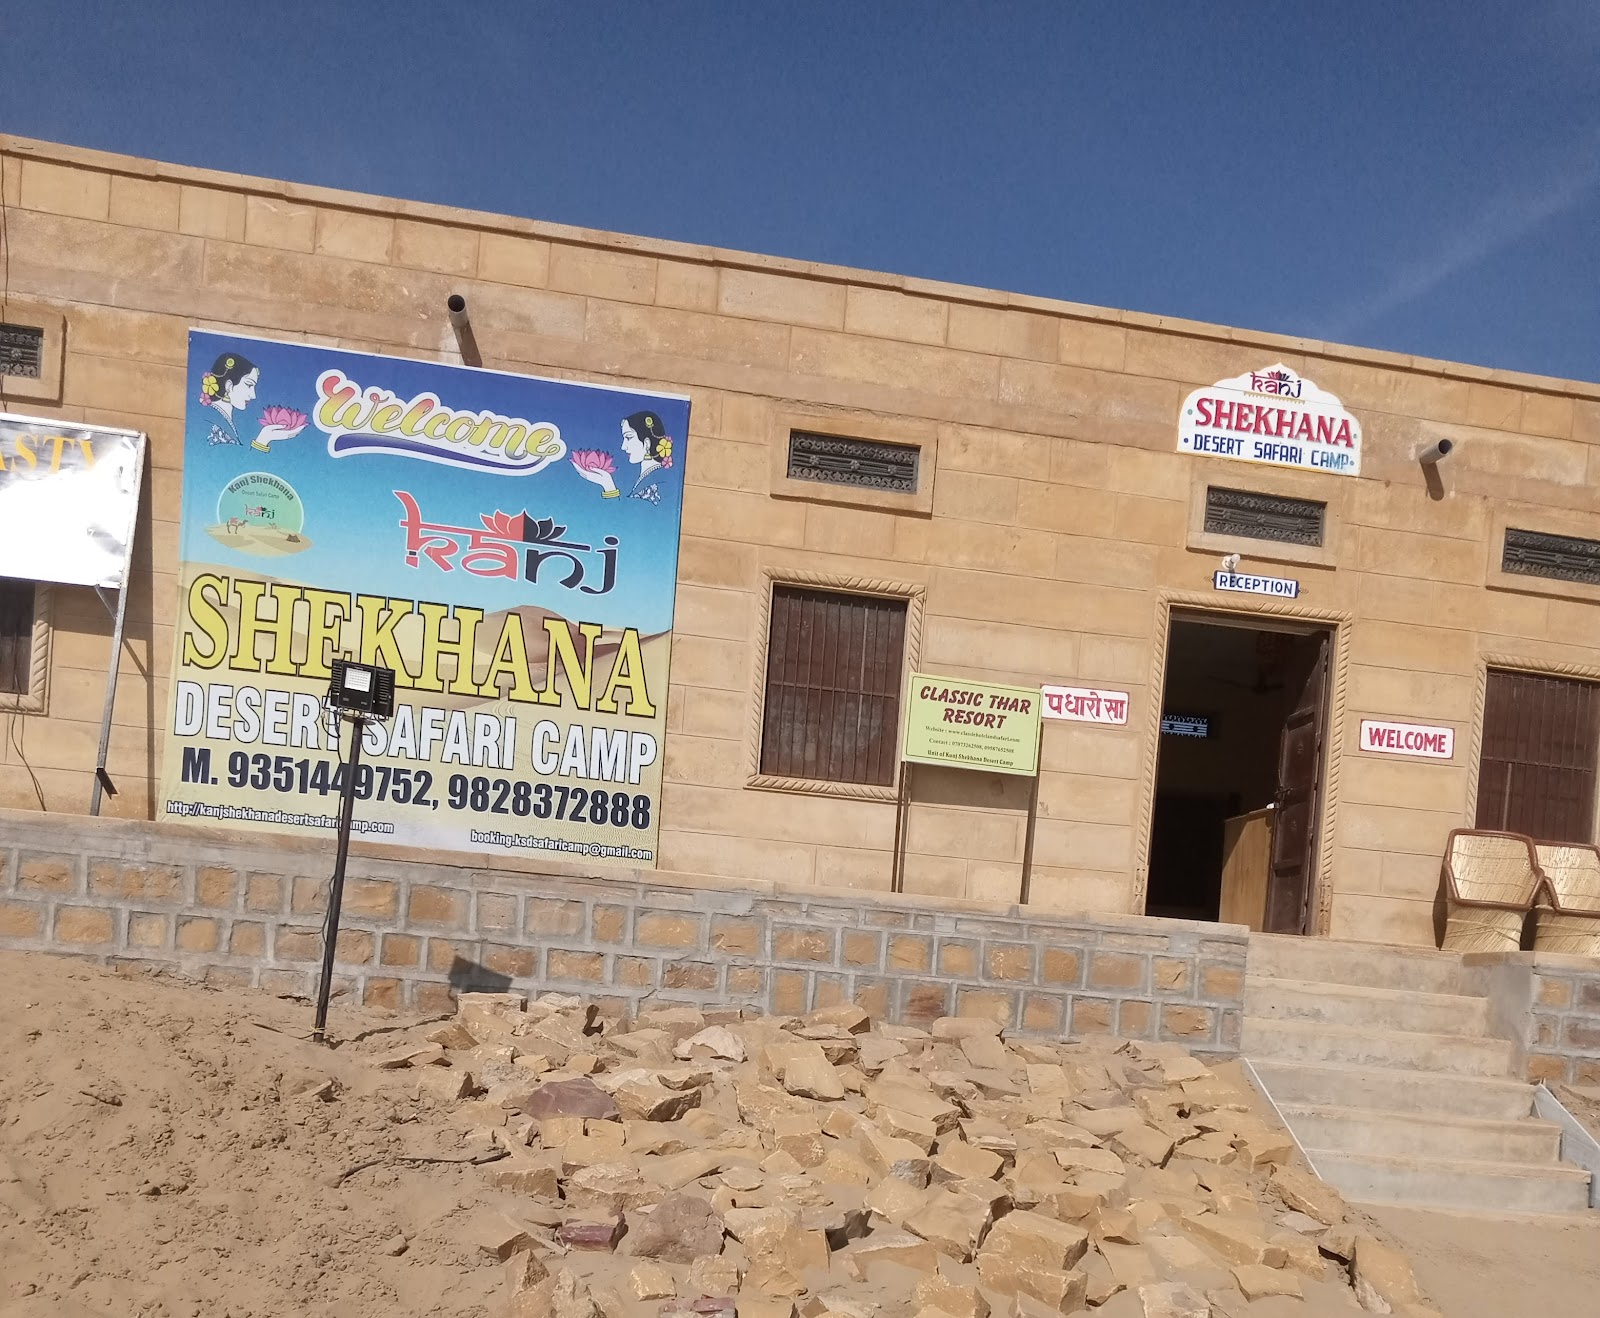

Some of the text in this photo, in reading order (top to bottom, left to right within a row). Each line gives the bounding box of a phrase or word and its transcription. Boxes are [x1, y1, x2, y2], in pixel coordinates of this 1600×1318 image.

[317, 373, 563, 466] Welcome
[1195, 398, 1355, 449] SHEKHANA
[1193, 434, 1350, 470] DESERT SAFARI CAMP
[250, 475, 294, 501] Shekhana
[1219, 575, 1294, 595] RECEPTION
[182, 573, 656, 719] SHEKHANA
[919, 685, 1032, 715] CLASSIC THAR
[174, 680, 343, 752] DESERT
[531, 719, 658, 785] CAMP
[942, 708, 1007, 729] RESORT
[1368, 727, 1448, 753] WELCOME
[181, 747, 219, 786] M.
[448, 774, 651, 829] 9828372888
[471, 829, 653, 860] booking.ksdsafaricamp@gmail.com
